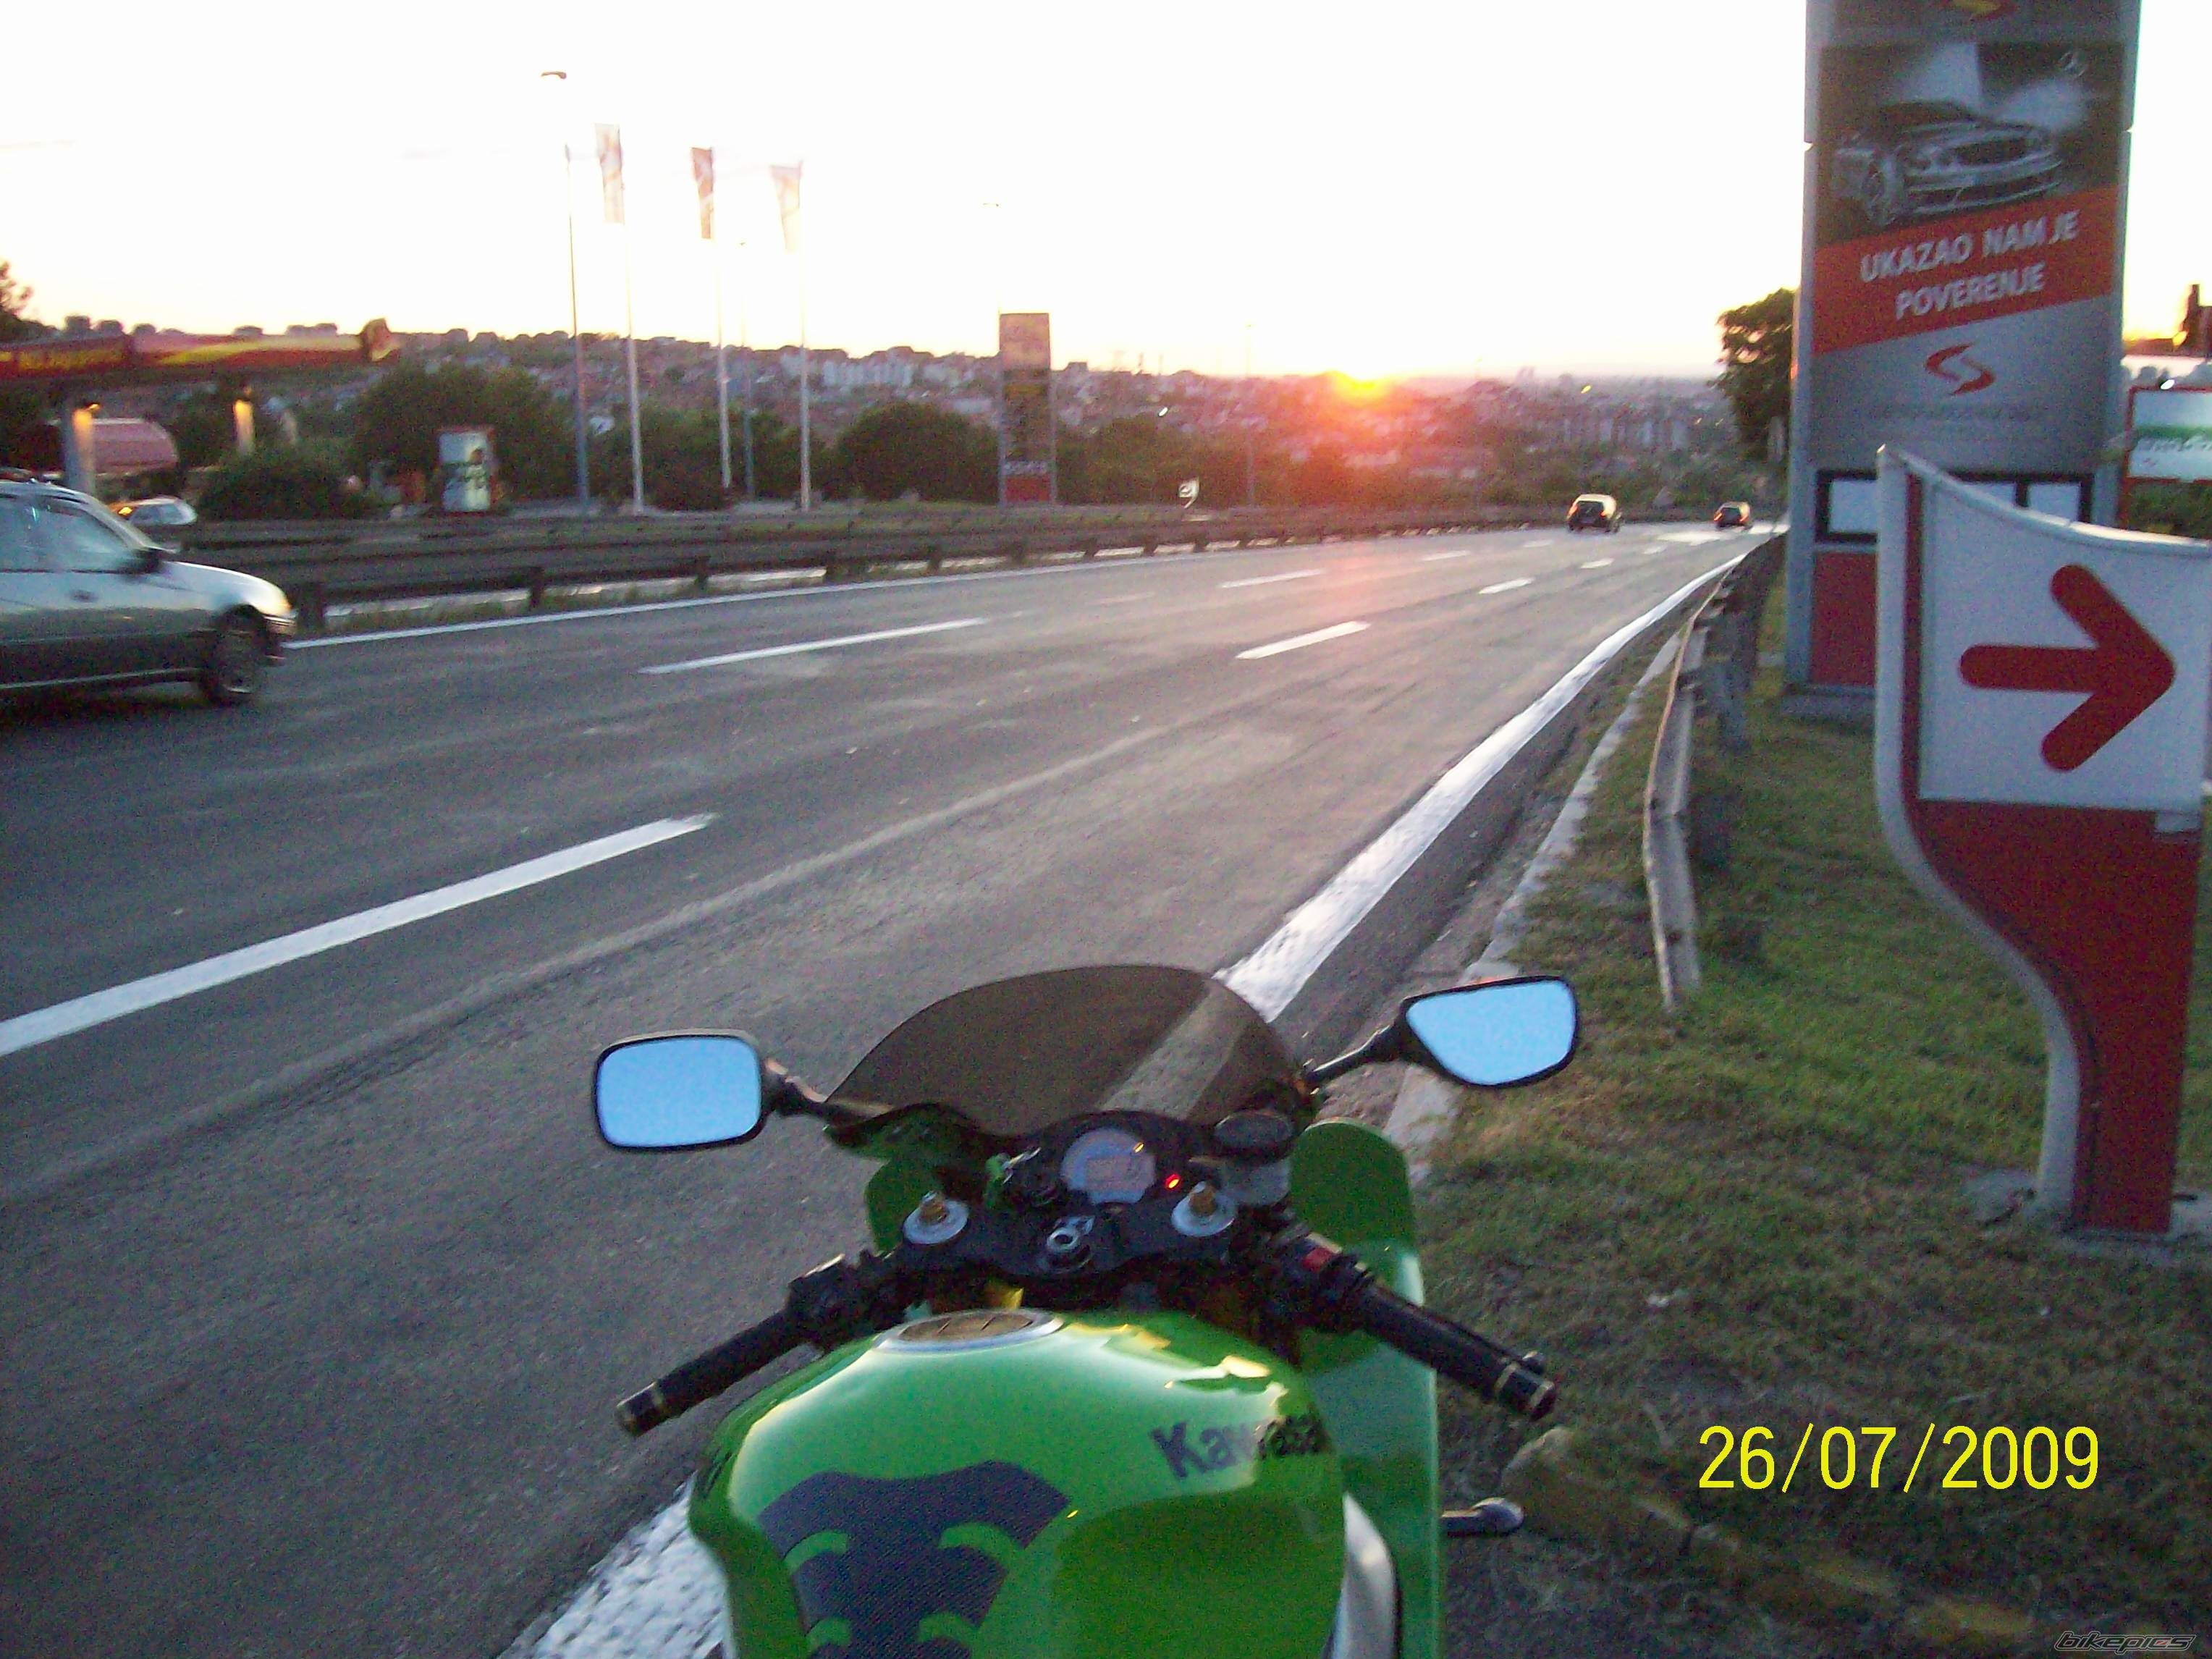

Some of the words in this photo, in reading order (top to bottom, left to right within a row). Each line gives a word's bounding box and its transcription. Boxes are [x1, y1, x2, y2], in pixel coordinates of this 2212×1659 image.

[1859, 233, 1973, 282] UKAZAO
[1982, 217, 2047, 257] NAM
[2048, 209, 2080, 245] JE
[1895, 262, 2046, 319] POVERENJE
